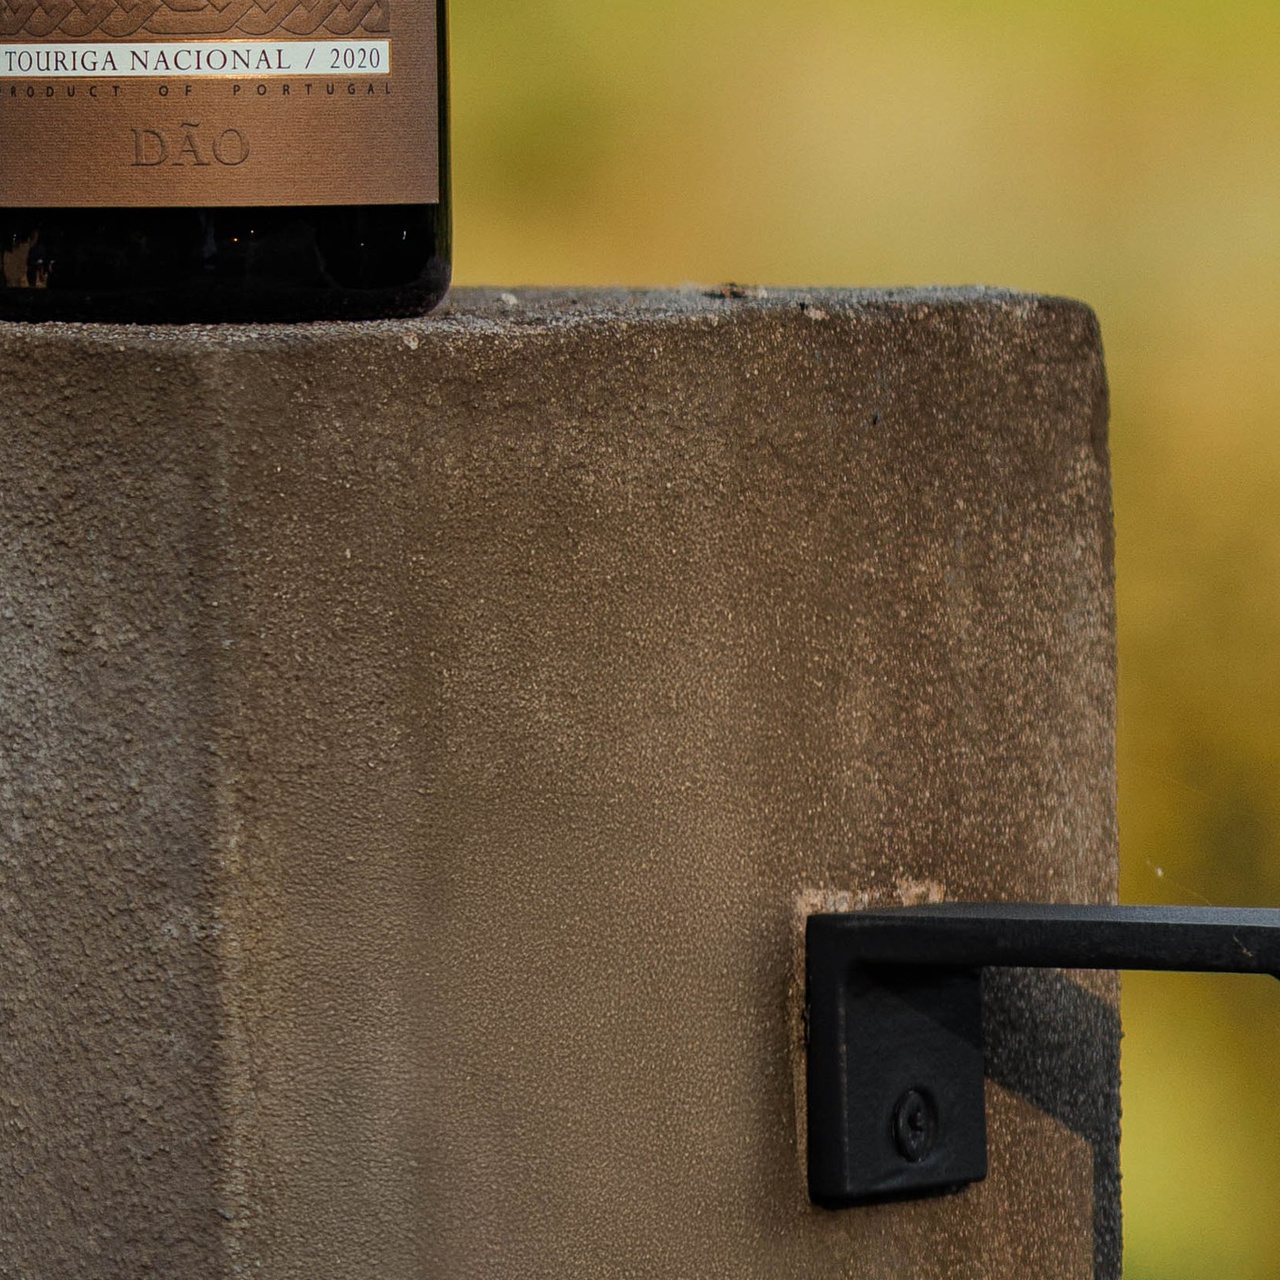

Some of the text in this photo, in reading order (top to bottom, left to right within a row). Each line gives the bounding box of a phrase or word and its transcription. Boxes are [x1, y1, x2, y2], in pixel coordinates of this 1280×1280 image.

[4, 49, 118, 73] TOURIGA
[130, 47, 292, 72] NACIONAL
[329, 46, 381, 70] 2020
[158, 84, 194, 98] OF
[232, 81, 391, 97] PORTUGAL
[130, 121, 251, 168] DÃO
